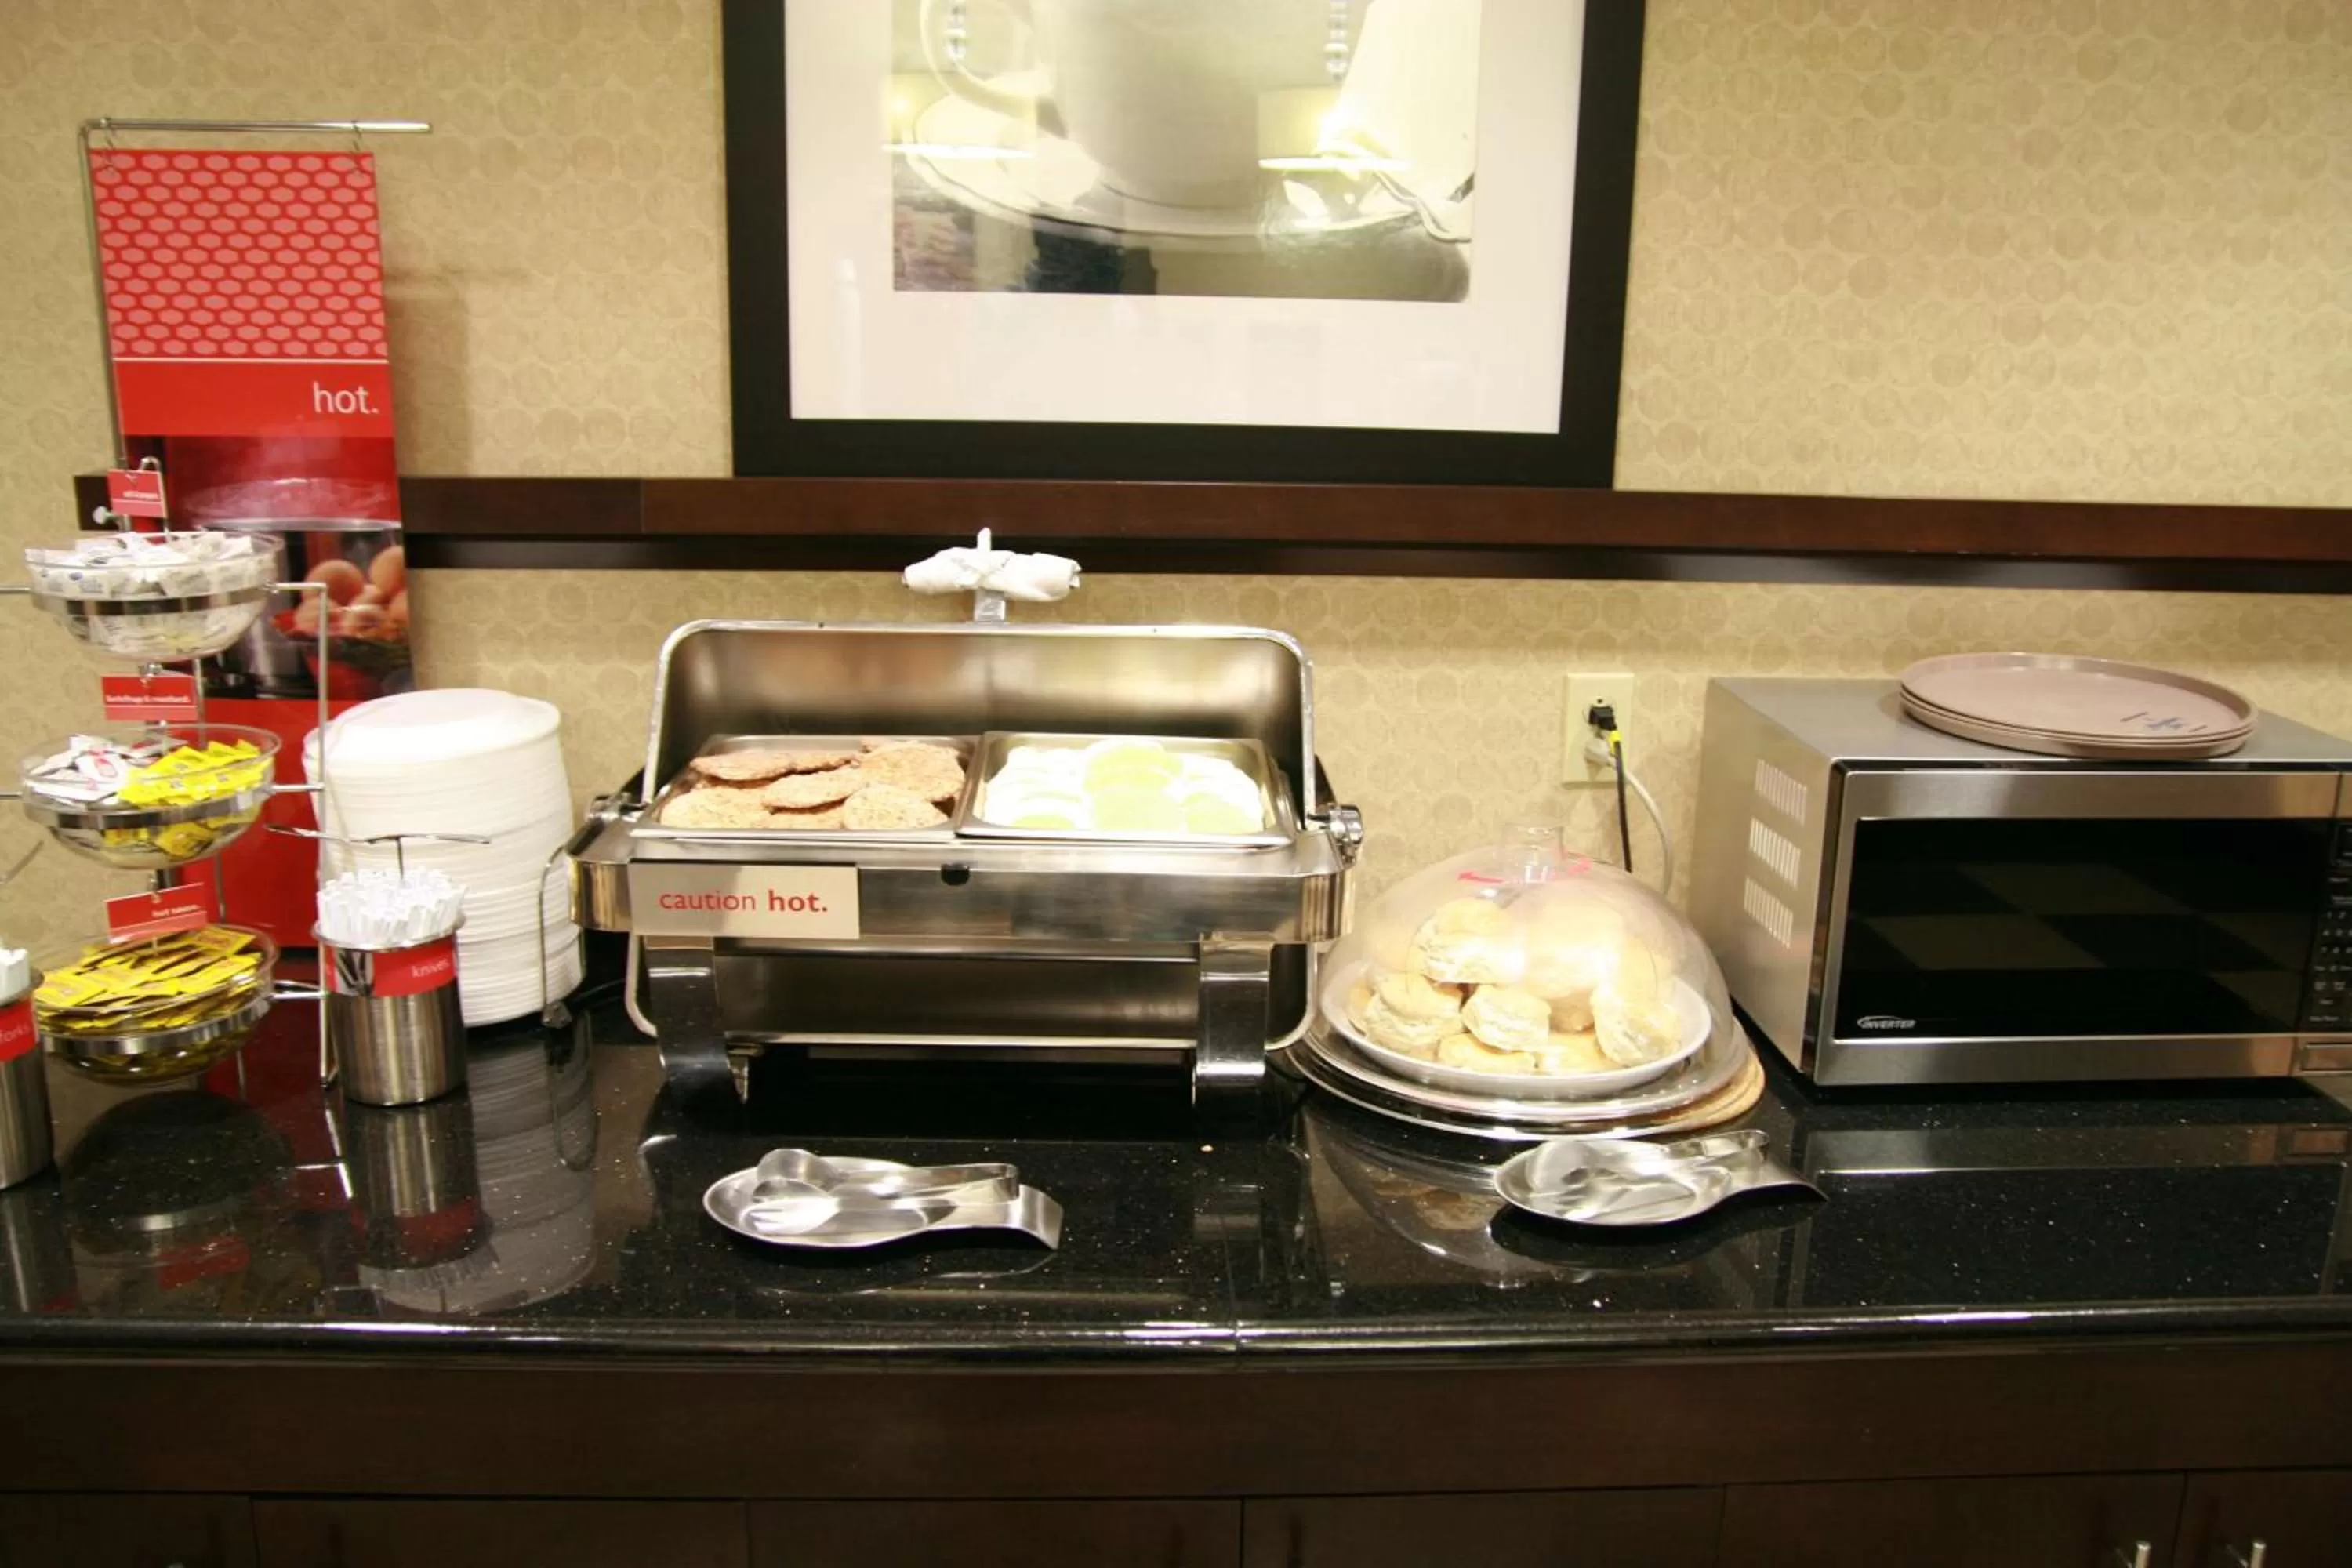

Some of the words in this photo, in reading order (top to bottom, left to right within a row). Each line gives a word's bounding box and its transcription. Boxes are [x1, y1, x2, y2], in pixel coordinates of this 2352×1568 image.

[313, 380, 380, 415] hot.
[659, 890, 757, 911] caution
[768, 888, 829, 913] hot.
